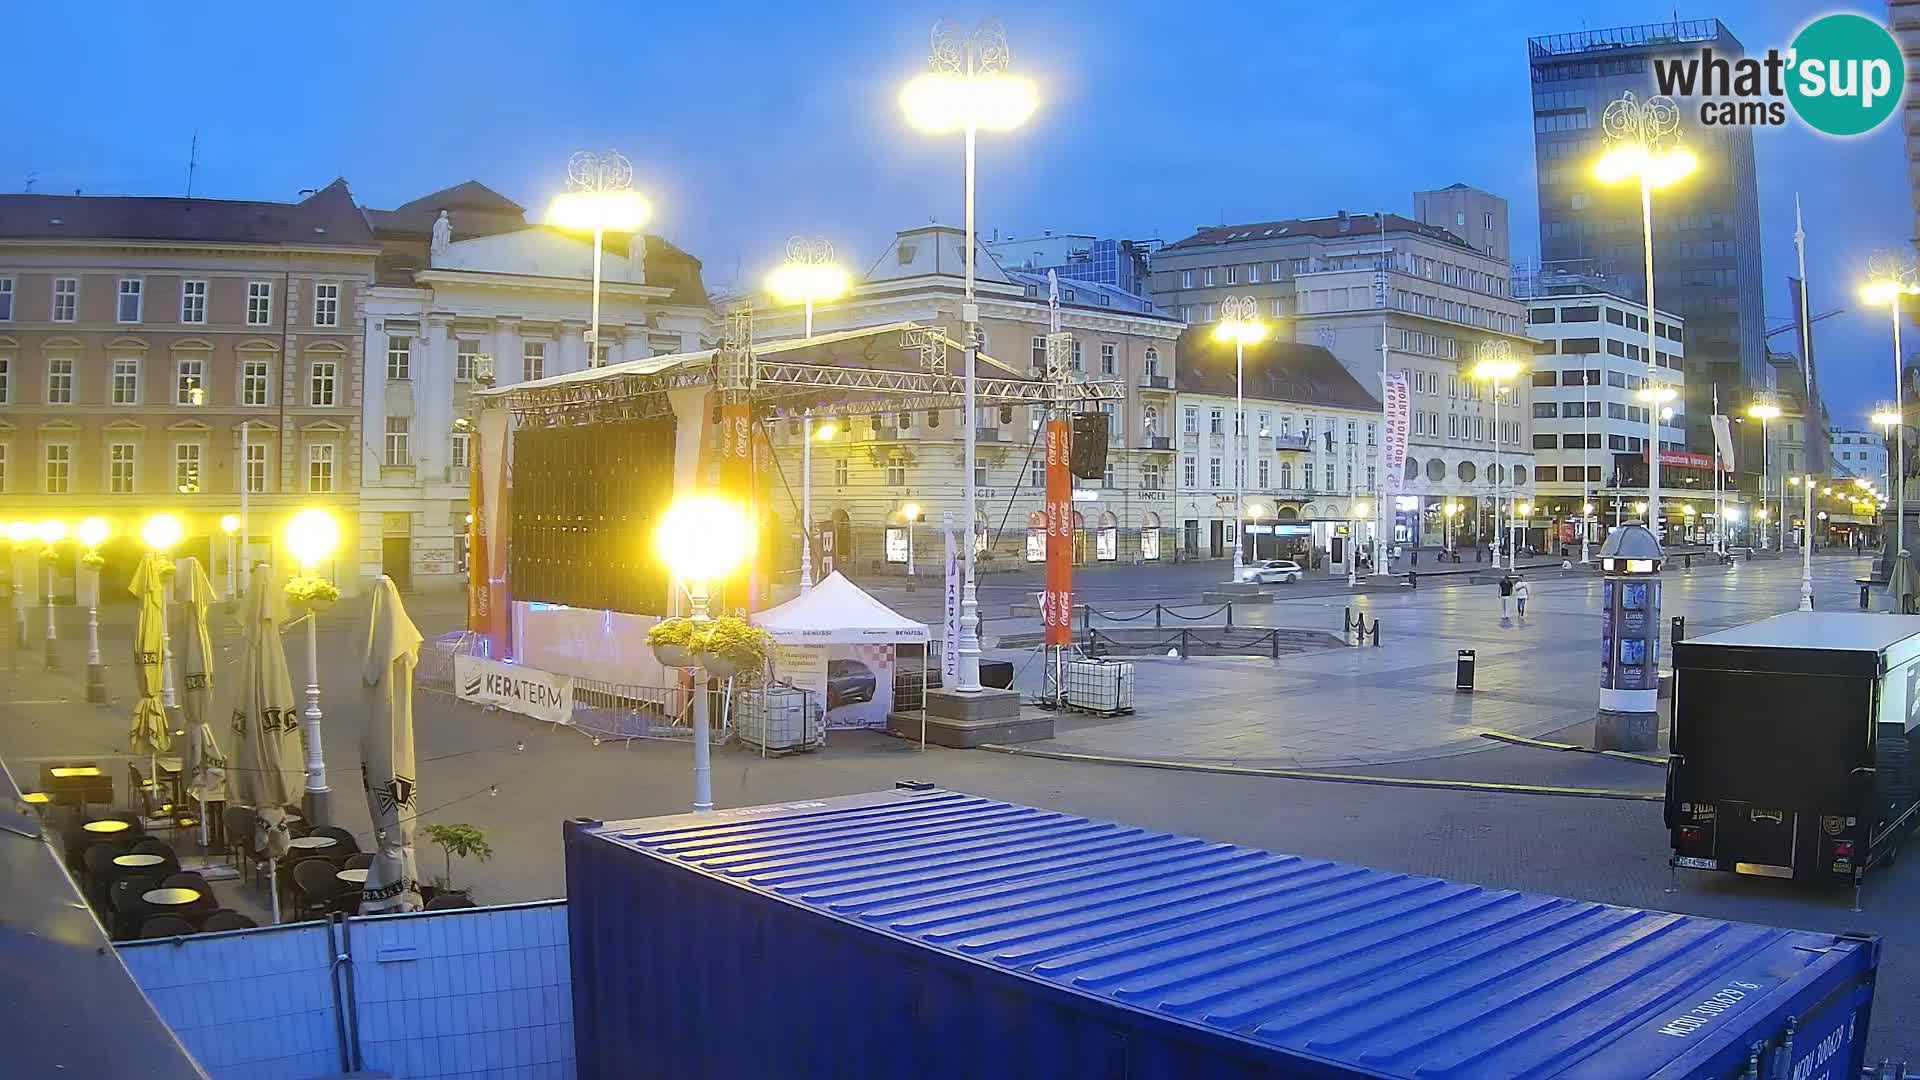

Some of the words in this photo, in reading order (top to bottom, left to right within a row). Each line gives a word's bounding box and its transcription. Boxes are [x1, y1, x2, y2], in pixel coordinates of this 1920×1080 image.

[1138, 491, 1166, 501] SINGER
[486, 673, 562, 710] KERATERM
[1658, 1014, 1708, 1037] MCDU
[1691, 988, 1746, 1017] 300629
